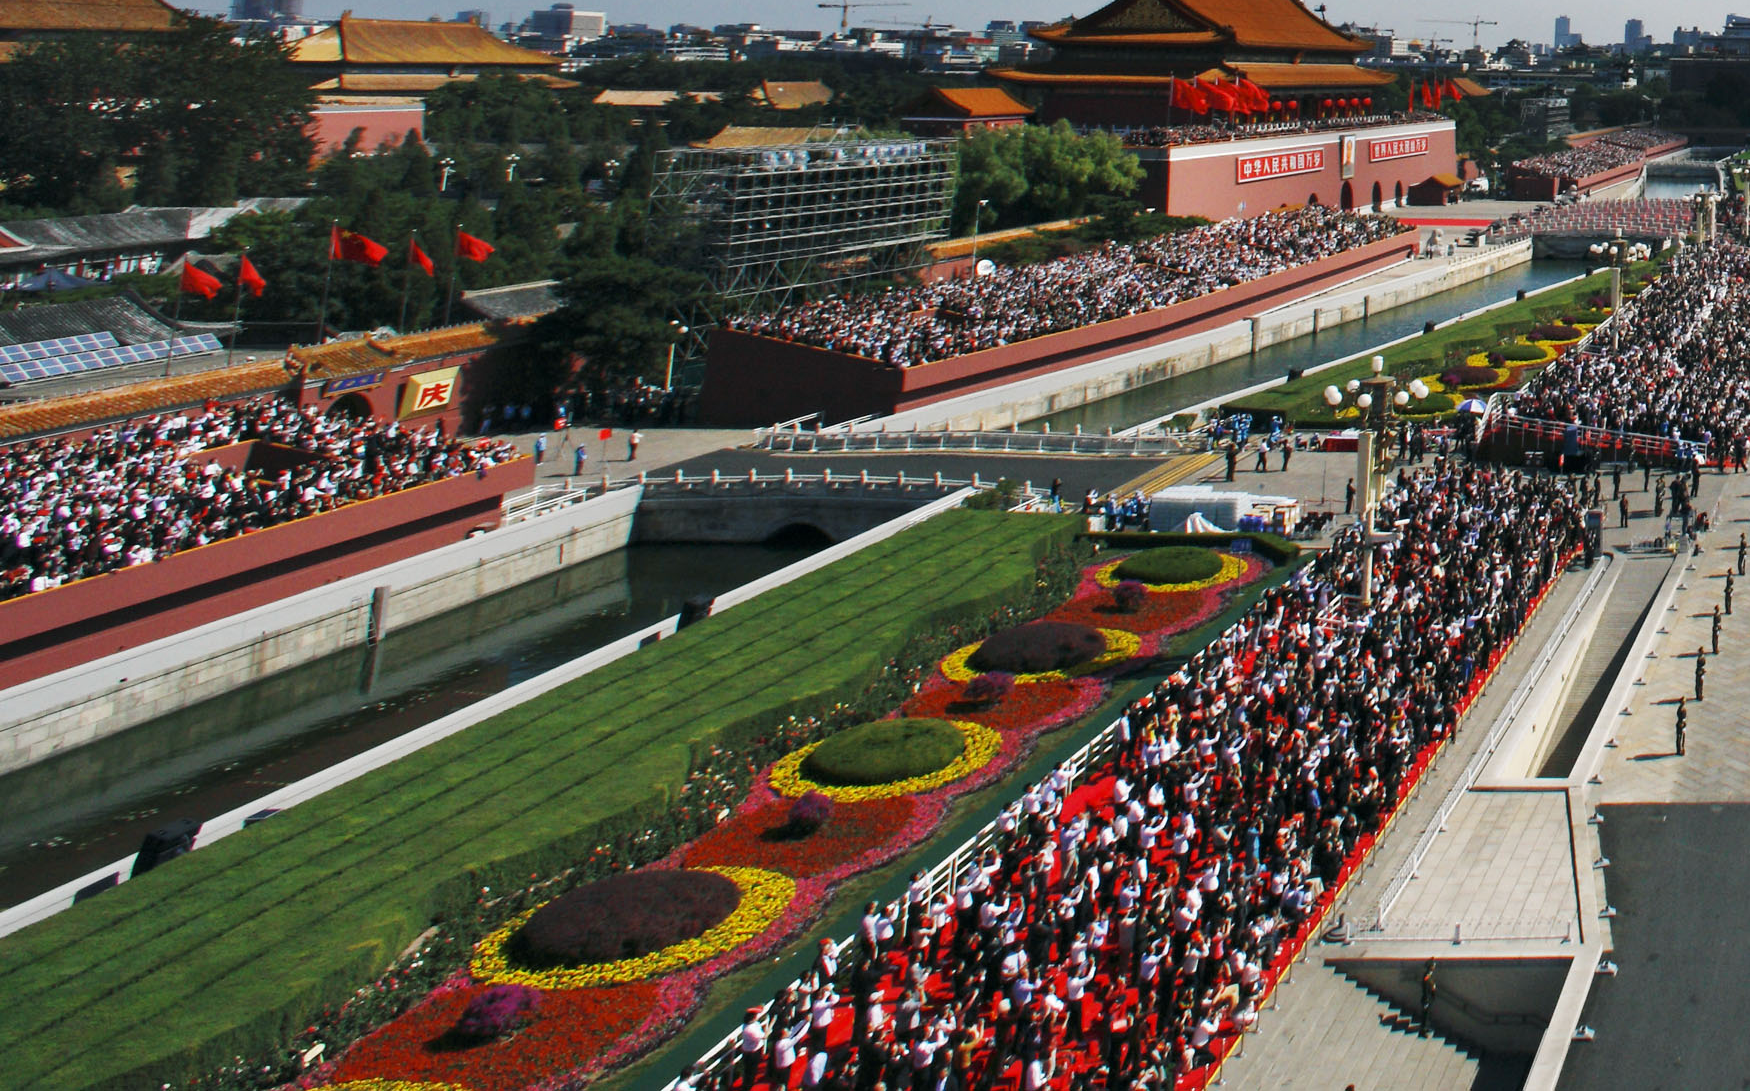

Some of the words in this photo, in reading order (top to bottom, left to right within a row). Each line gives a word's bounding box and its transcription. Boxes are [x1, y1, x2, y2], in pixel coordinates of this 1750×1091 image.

[1243, 152, 1320, 177] 中华人民共和国万岁
[417, 384, 449, 408] 庆
